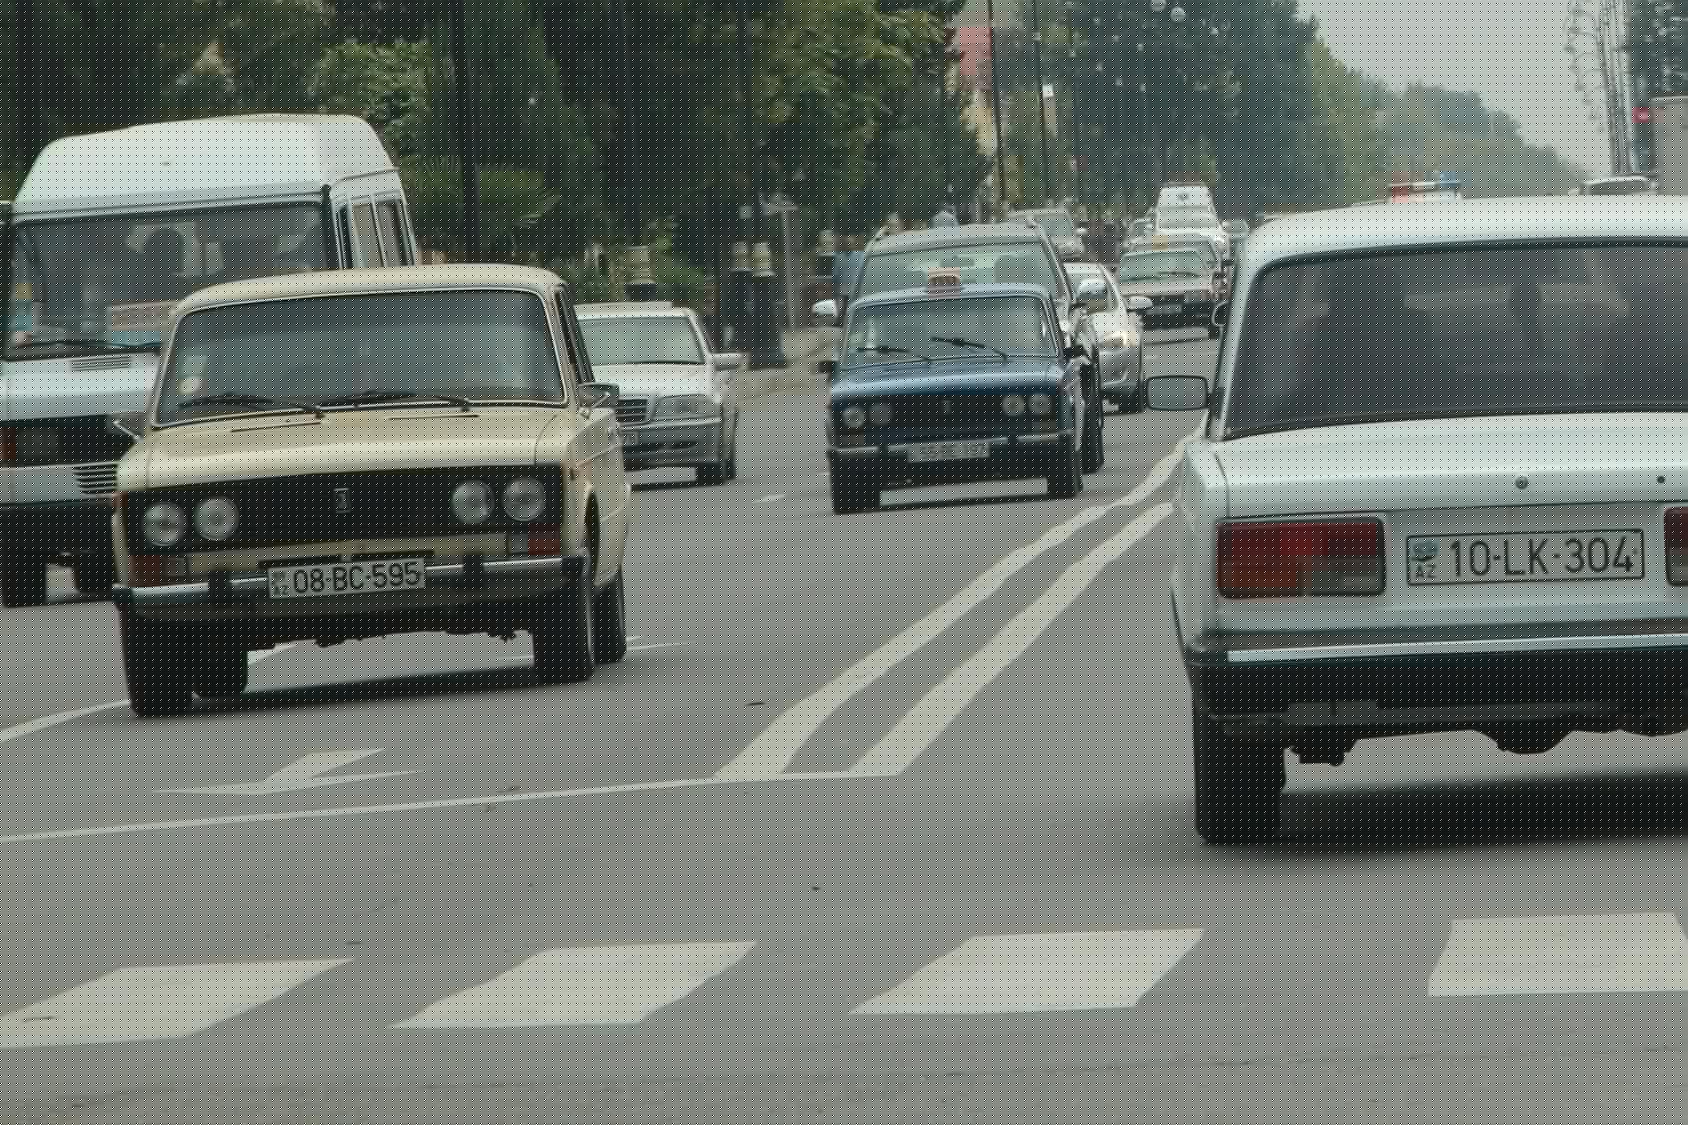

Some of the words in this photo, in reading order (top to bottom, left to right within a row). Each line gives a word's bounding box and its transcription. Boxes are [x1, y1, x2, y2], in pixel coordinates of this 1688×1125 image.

[1414, 564, 1437, 579] AZ
[1450, 535, 1634, 577] 10-LK-304
[293, 561, 421, 594] 08-BC-595
